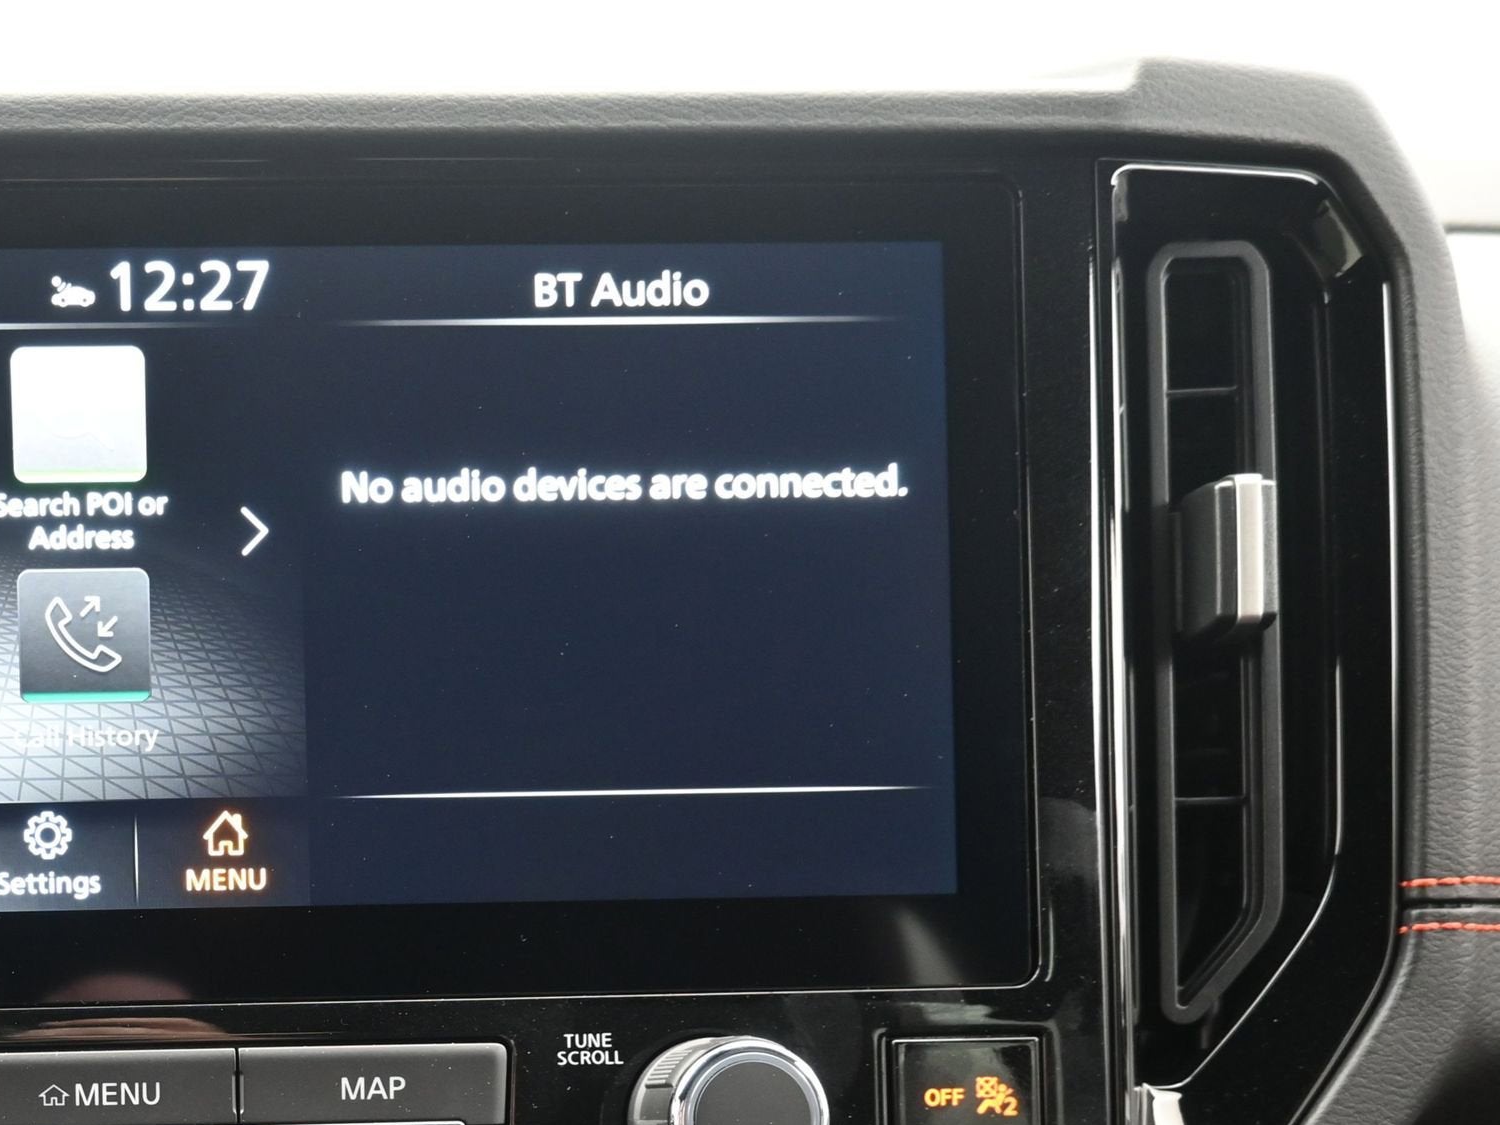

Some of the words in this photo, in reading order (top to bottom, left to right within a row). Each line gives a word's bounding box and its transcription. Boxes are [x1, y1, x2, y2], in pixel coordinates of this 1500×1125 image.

[109, 260, 270, 312] 12:27
[533, 272, 585, 308] BT
[591, 269, 709, 309] Audio
[341, 471, 393, 504] No
[401, 469, 506, 502] audio
[513, 467, 642, 501] devices
[649, 475, 706, 500] are
[714, 462, 909, 499] connected.
[87, 491, 132, 516] POI
[138, 495, 169, 516] or
[28, 523, 135, 550] Address
[68, 723, 160, 751] History
[185, 868, 267, 892] MENU
[563, 1033, 613, 1049] TUNE
[557, 1049, 625, 1066] SCROLL
[74, 1082, 162, 1107] MENU
[340, 1076, 407, 1101] MAP
[924, 1088, 966, 1107] OFF
